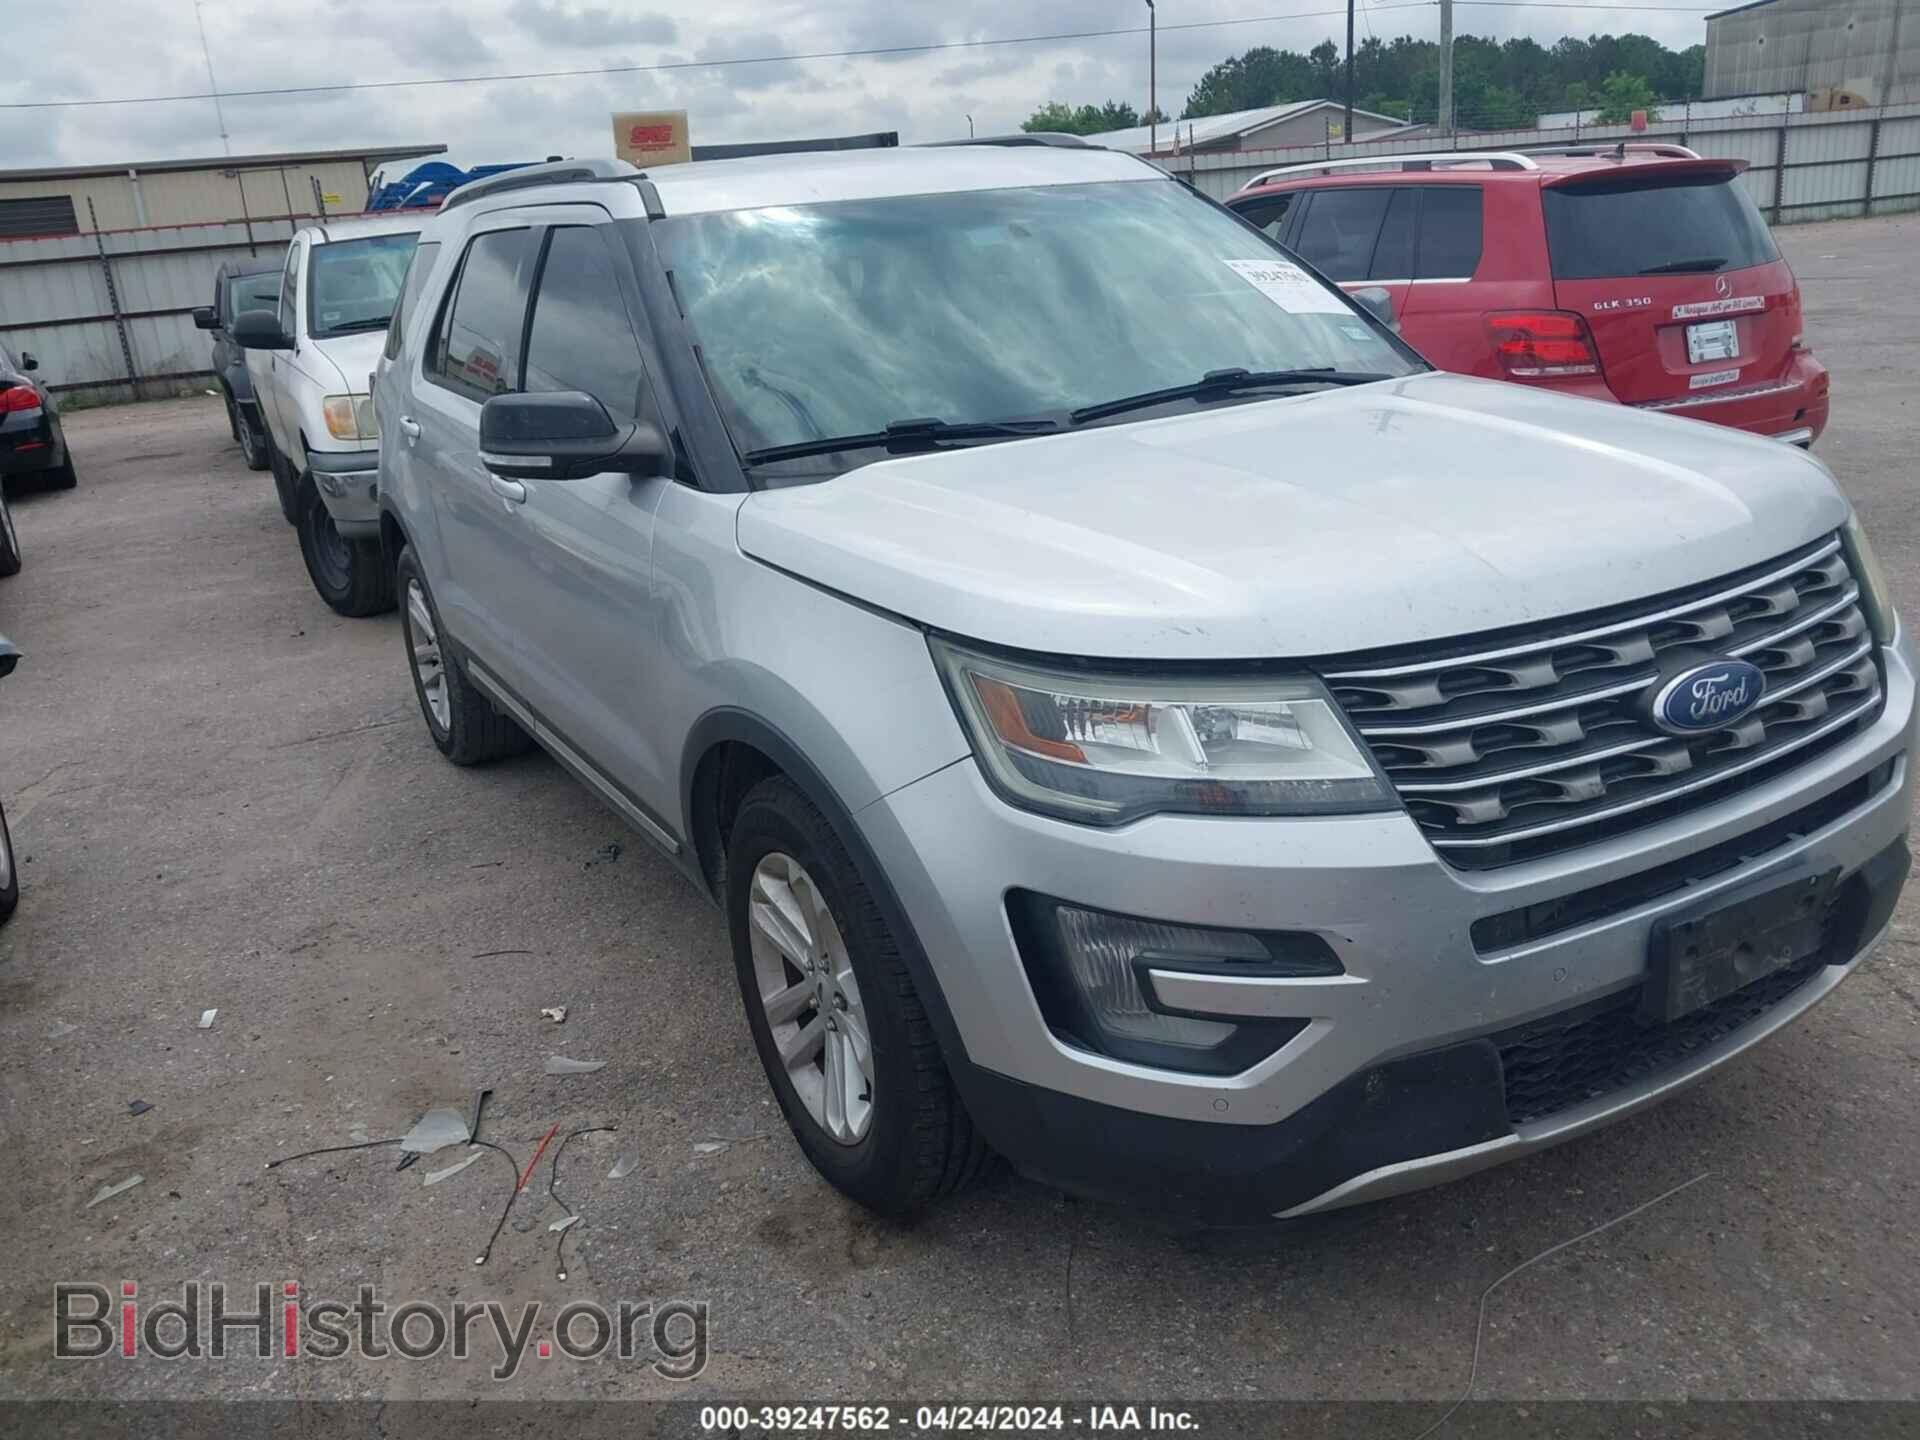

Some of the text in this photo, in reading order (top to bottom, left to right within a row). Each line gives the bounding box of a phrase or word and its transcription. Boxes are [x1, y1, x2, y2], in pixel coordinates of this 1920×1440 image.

[1593, 297, 1652, 310] GLK 350
[1690, 673, 1748, 718] Ford
